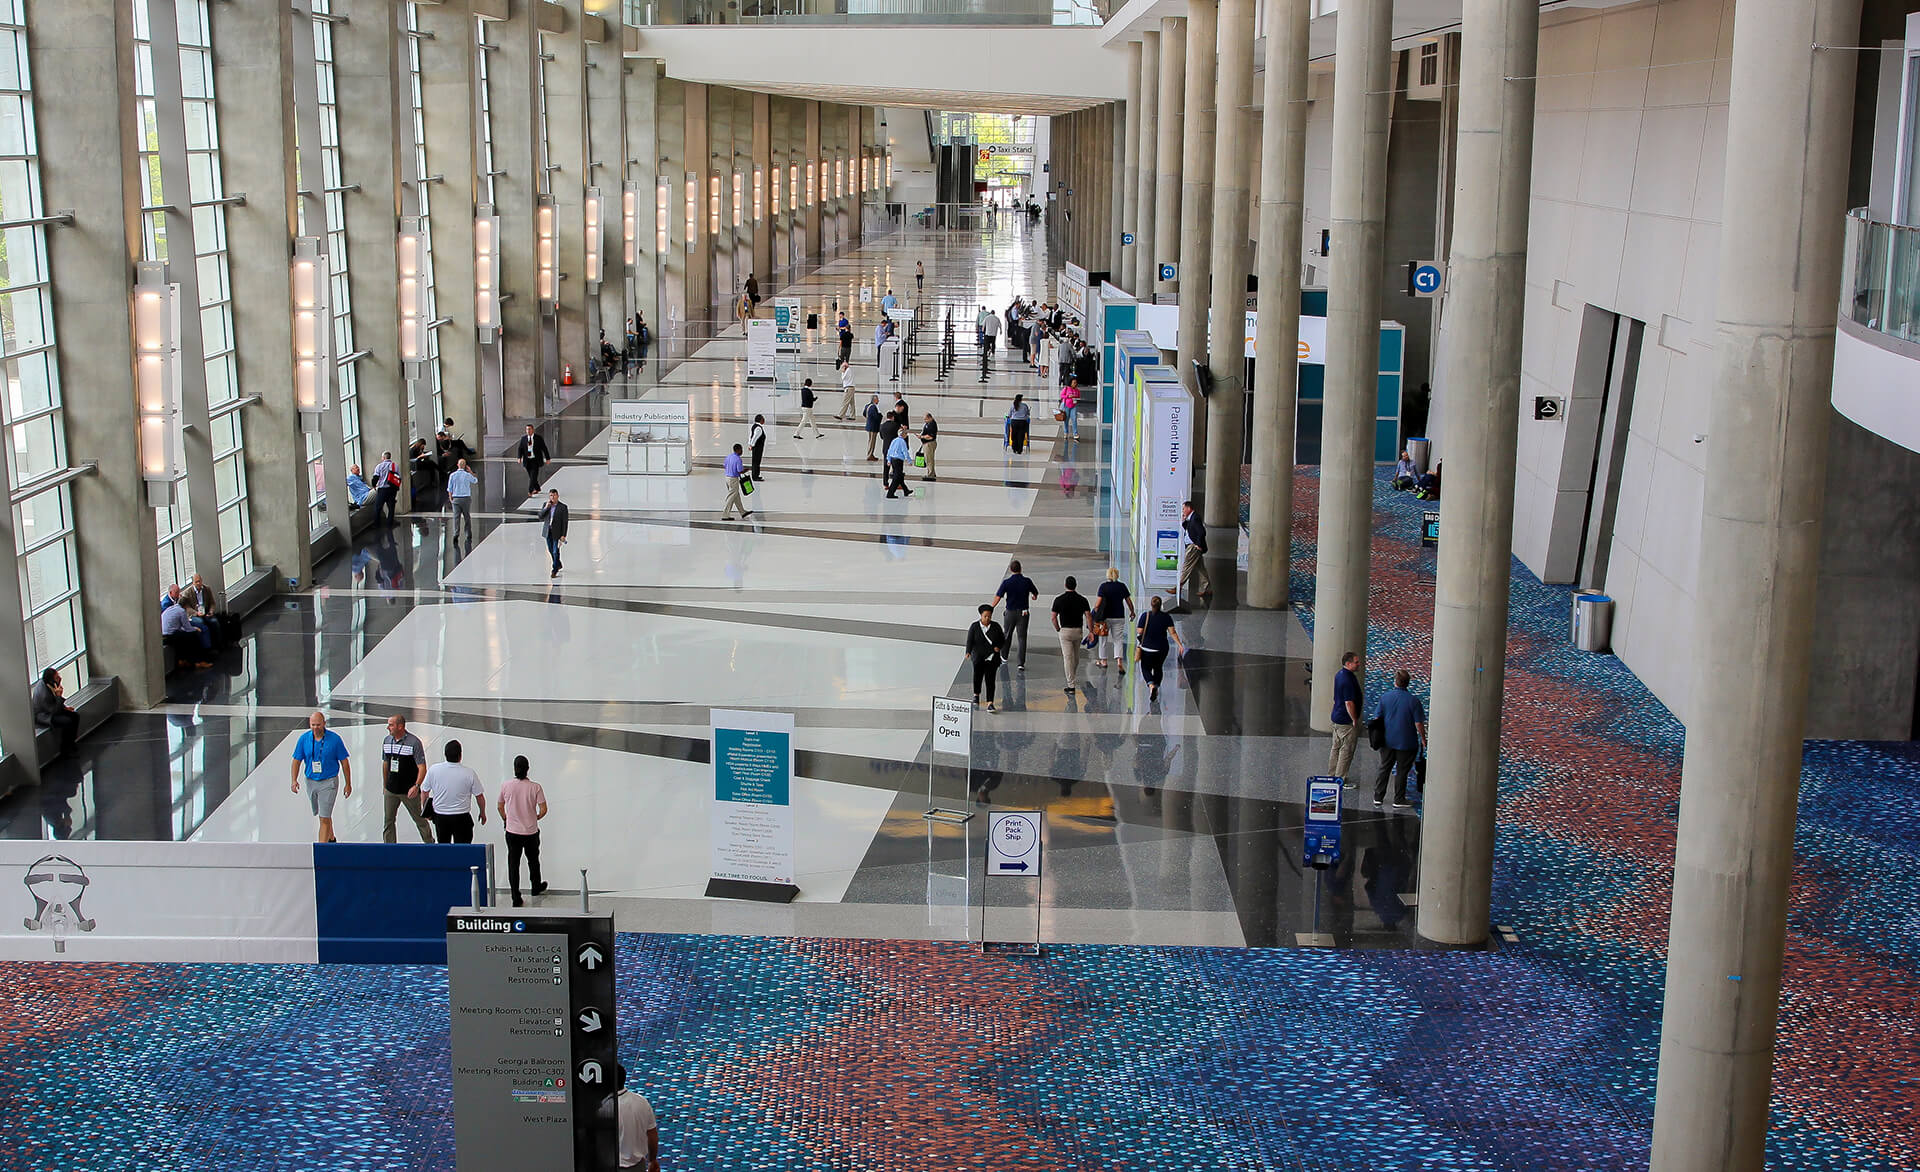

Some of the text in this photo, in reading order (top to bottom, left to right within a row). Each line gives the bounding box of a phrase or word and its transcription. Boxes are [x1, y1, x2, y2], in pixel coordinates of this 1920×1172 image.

[1416, 273, 1434, 287] C1
[614, 413, 643, 421] Industry
[1170, 406, 1181, 463] Patient Hub
[942, 713, 959, 724] Shop
[939, 725, 961, 738] Open
[456, 919, 523, 933] Building C
[485, 945, 513, 953] Exhibit
[516, 945, 534, 953] Halls
[510, 955, 550, 963] Taxi Stand
[508, 976, 550, 984] Restrooms
[459, 1007, 493, 1016] Meeting
[497, 1058, 529, 1066] Georgia
[458, 1067, 491, 1076] Meeting
[512, 1079, 543, 1087] Building
